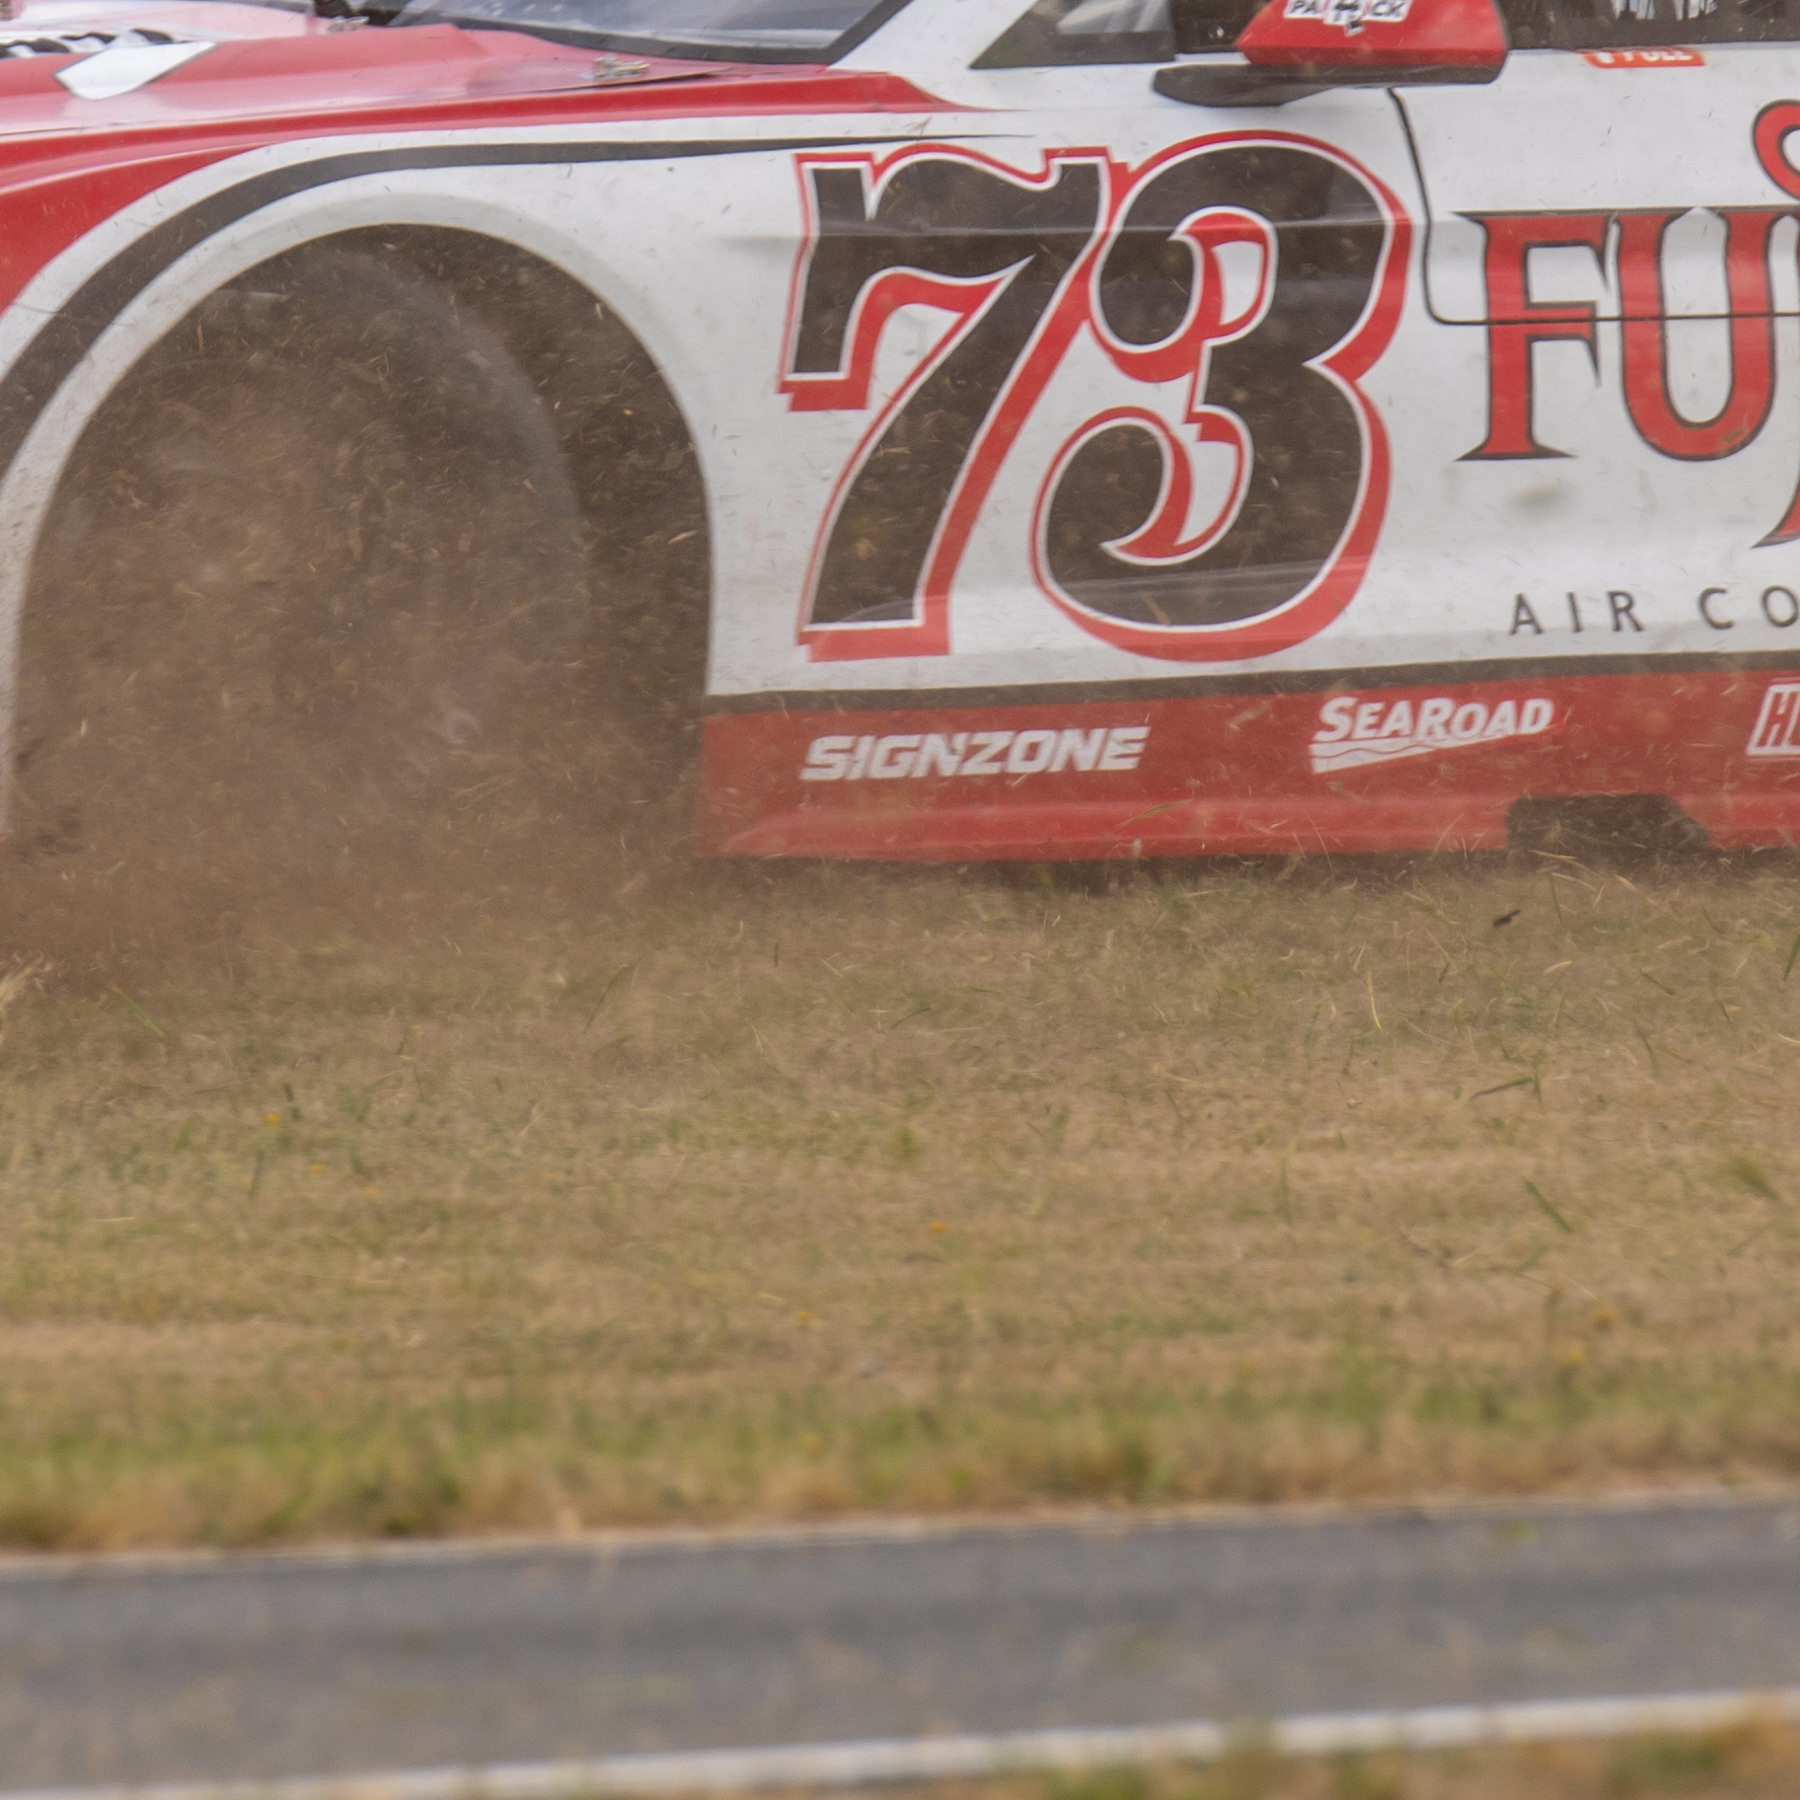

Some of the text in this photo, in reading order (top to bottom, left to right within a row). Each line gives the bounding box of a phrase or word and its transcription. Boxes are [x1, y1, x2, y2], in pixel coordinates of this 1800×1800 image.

[777, 130, 1415, 665] 73
[1508, 589, 1644, 637] AIR
[1313, 695, 1556, 743] SEAROAD
[800, 725, 1151, 781] SIGNZONE
